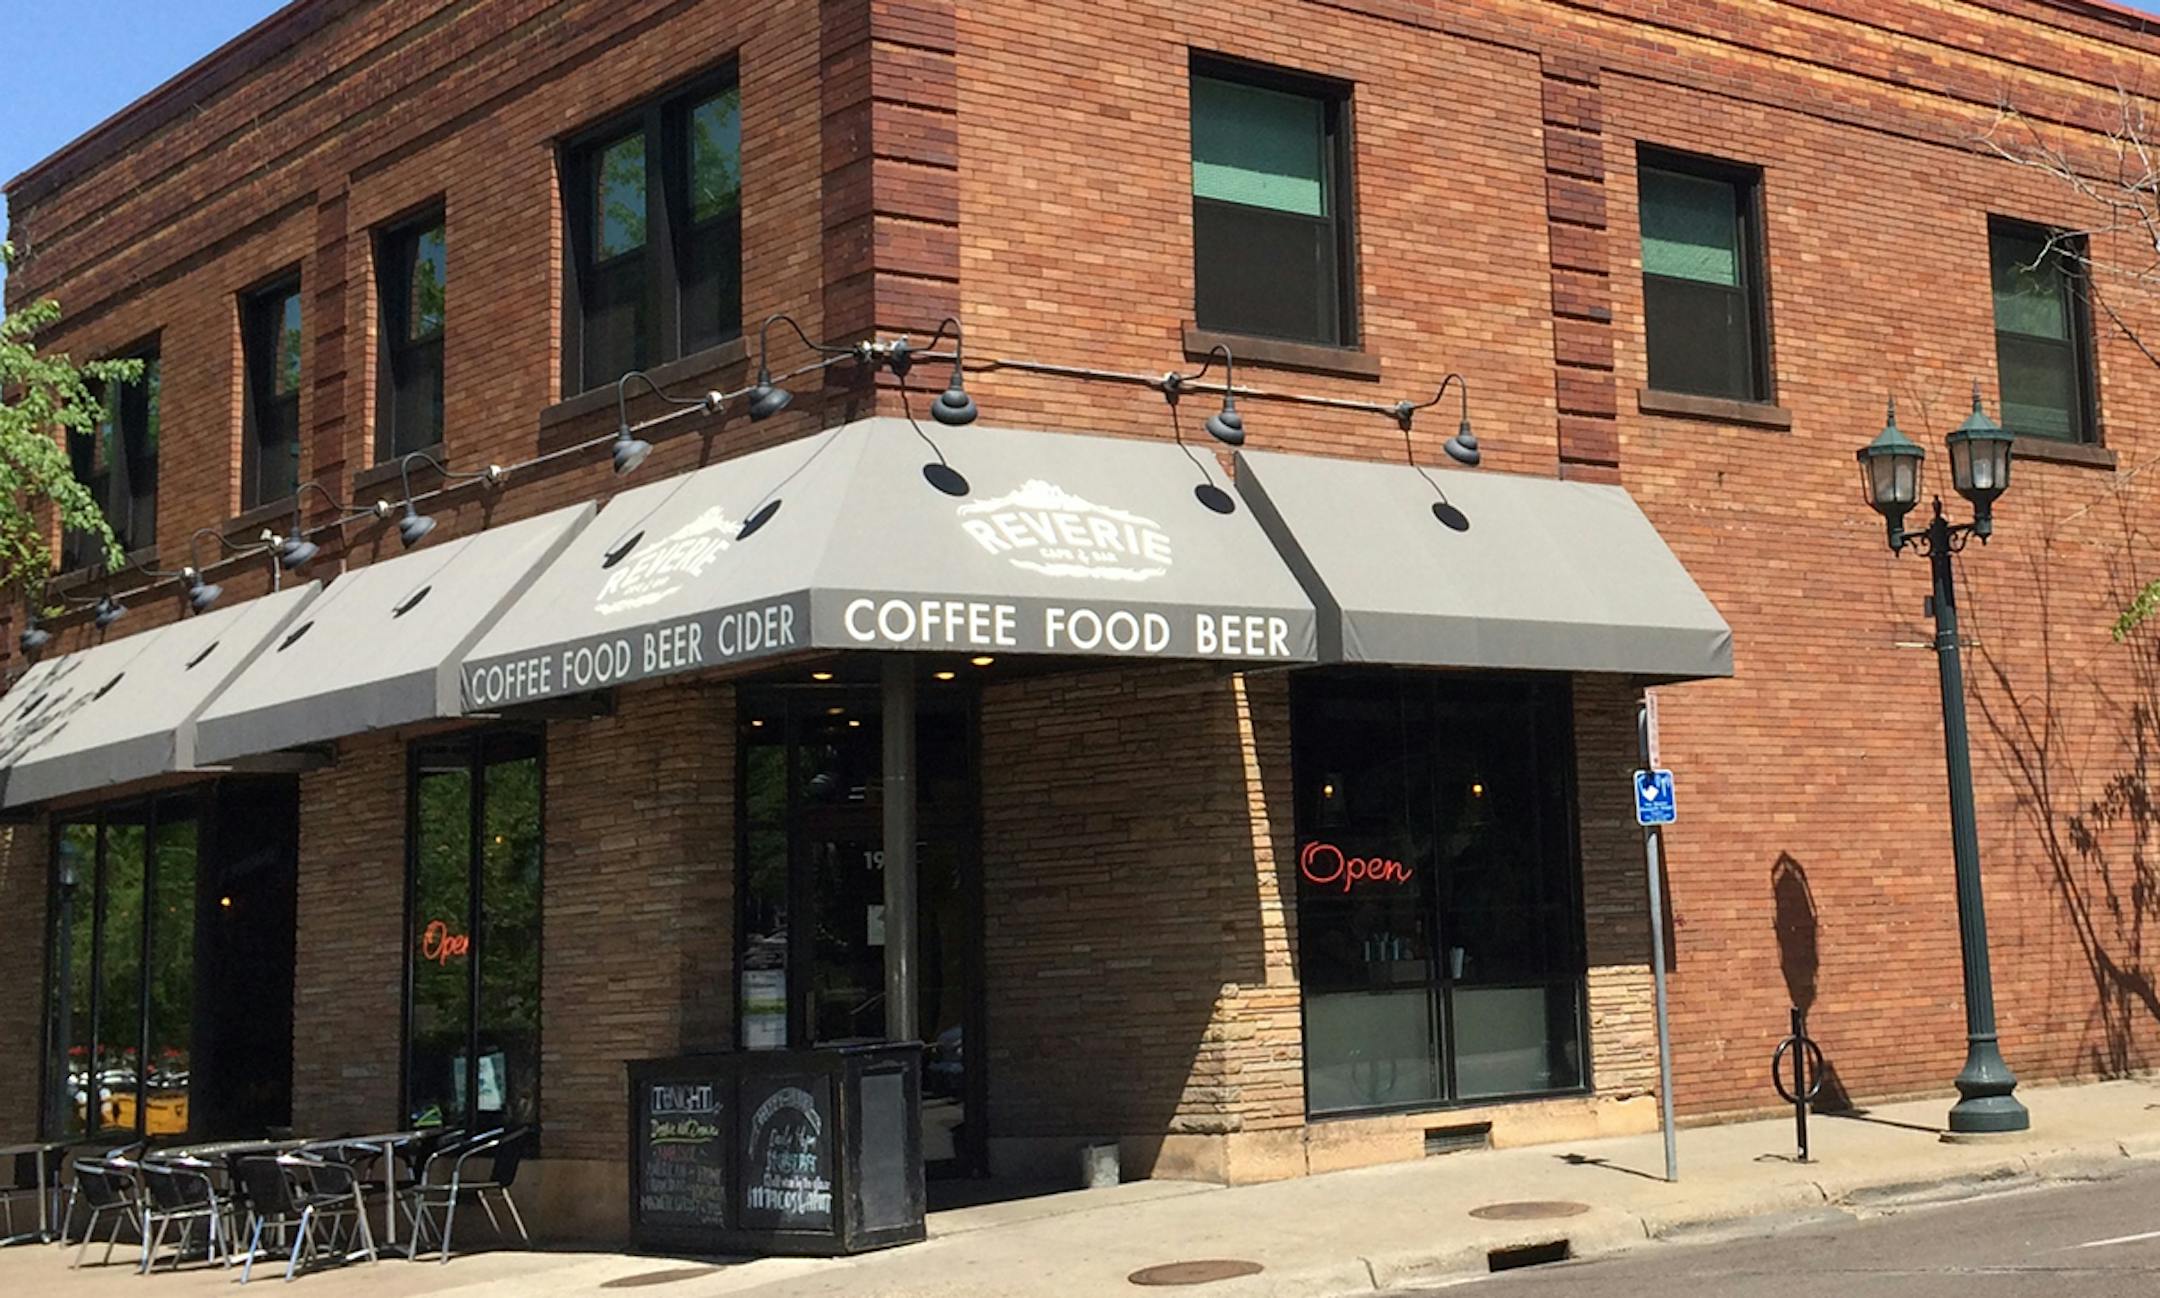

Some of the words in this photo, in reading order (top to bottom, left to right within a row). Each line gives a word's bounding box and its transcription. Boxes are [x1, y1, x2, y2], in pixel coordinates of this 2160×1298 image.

[961, 511, 1174, 566] REVERIE
[596, 536, 731, 601] REVERIE
[471, 655, 552, 705] COFFEE
[562, 639, 631, 689] FOOD
[643, 622, 704, 673] BEER
[718, 603, 796, 657] CIDER
[842, 598, 1017, 646] COFFEE
[1046, 607, 1170, 653] FOOD
[1197, 612, 1291, 657] BEER
[1300, 840, 1413, 892] Open
